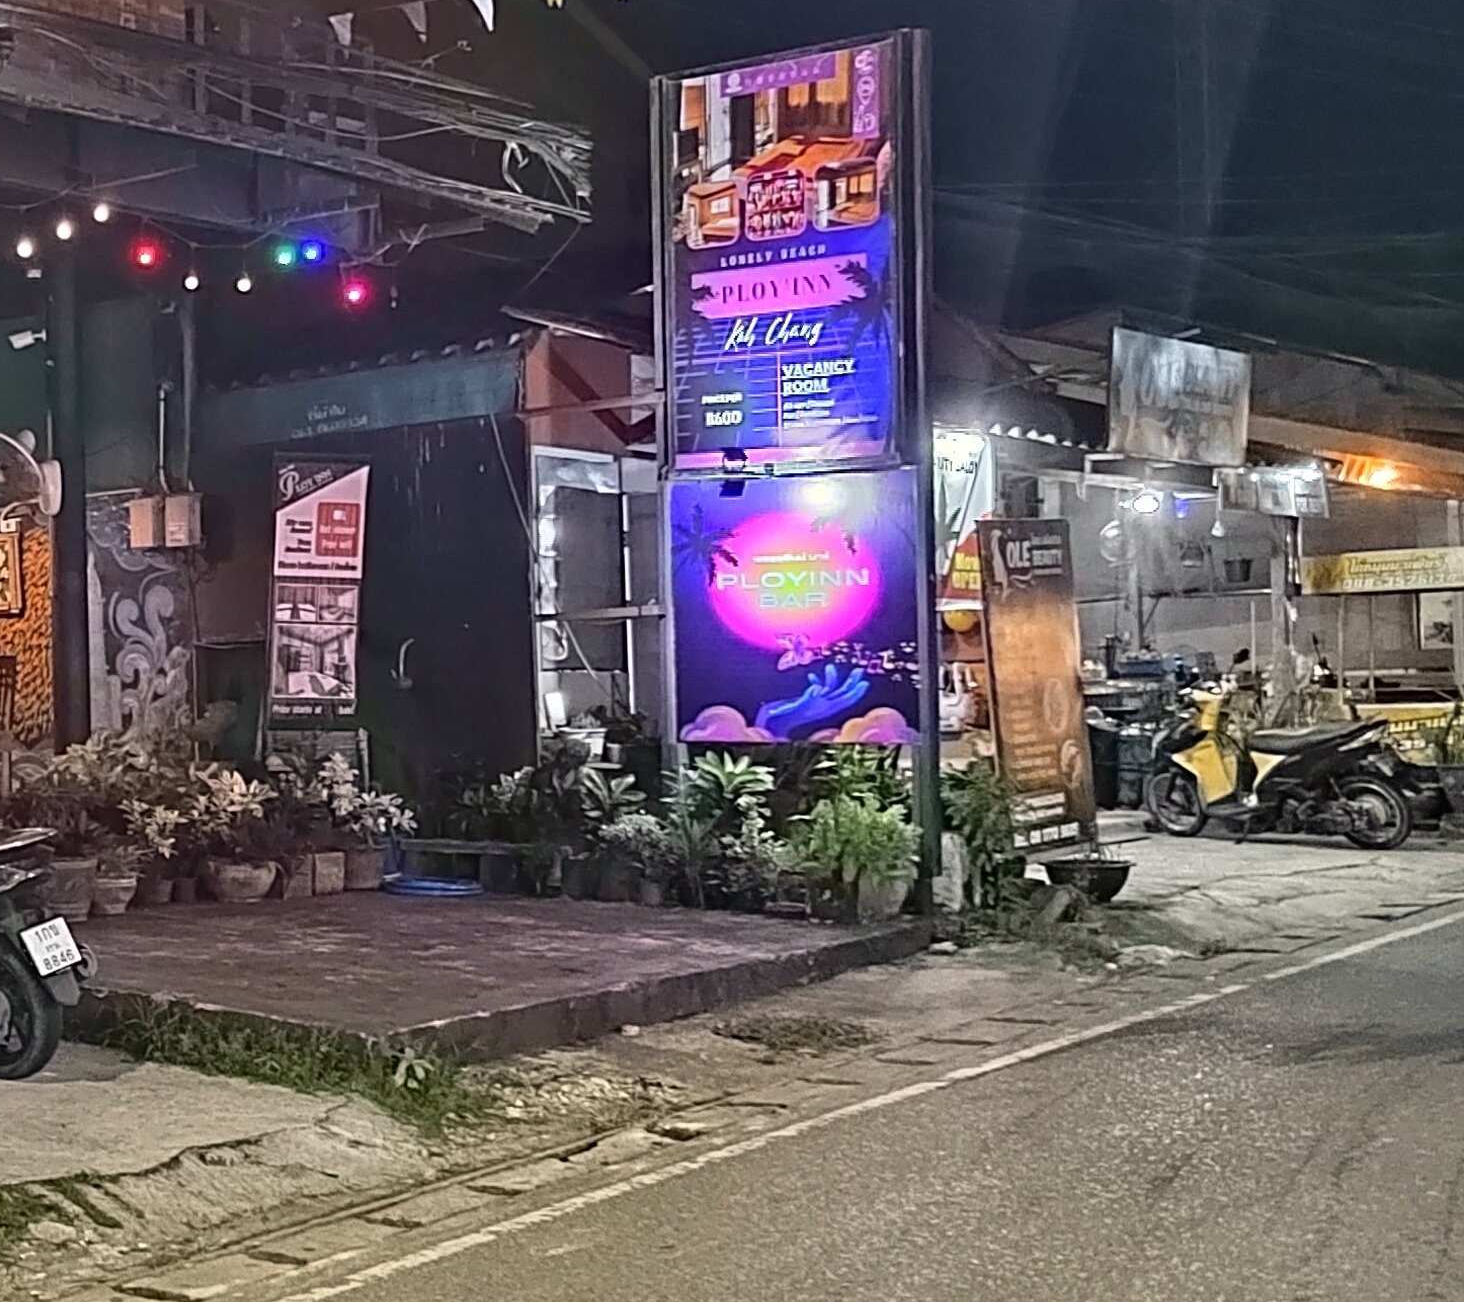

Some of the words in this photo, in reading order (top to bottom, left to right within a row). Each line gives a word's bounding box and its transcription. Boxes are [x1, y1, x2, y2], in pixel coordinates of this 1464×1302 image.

[720, 251, 773, 268] LONELY
[780, 244, 826, 260] BEACH
[765, 312, 825, 346] Chang
[782, 359, 856, 378] VACANCY
[783, 378, 830, 396] ROOM
[1006, 540, 1031, 568] OLE
[759, 592, 828, 609] BAR
[42, 949, 76, 972] 8846
